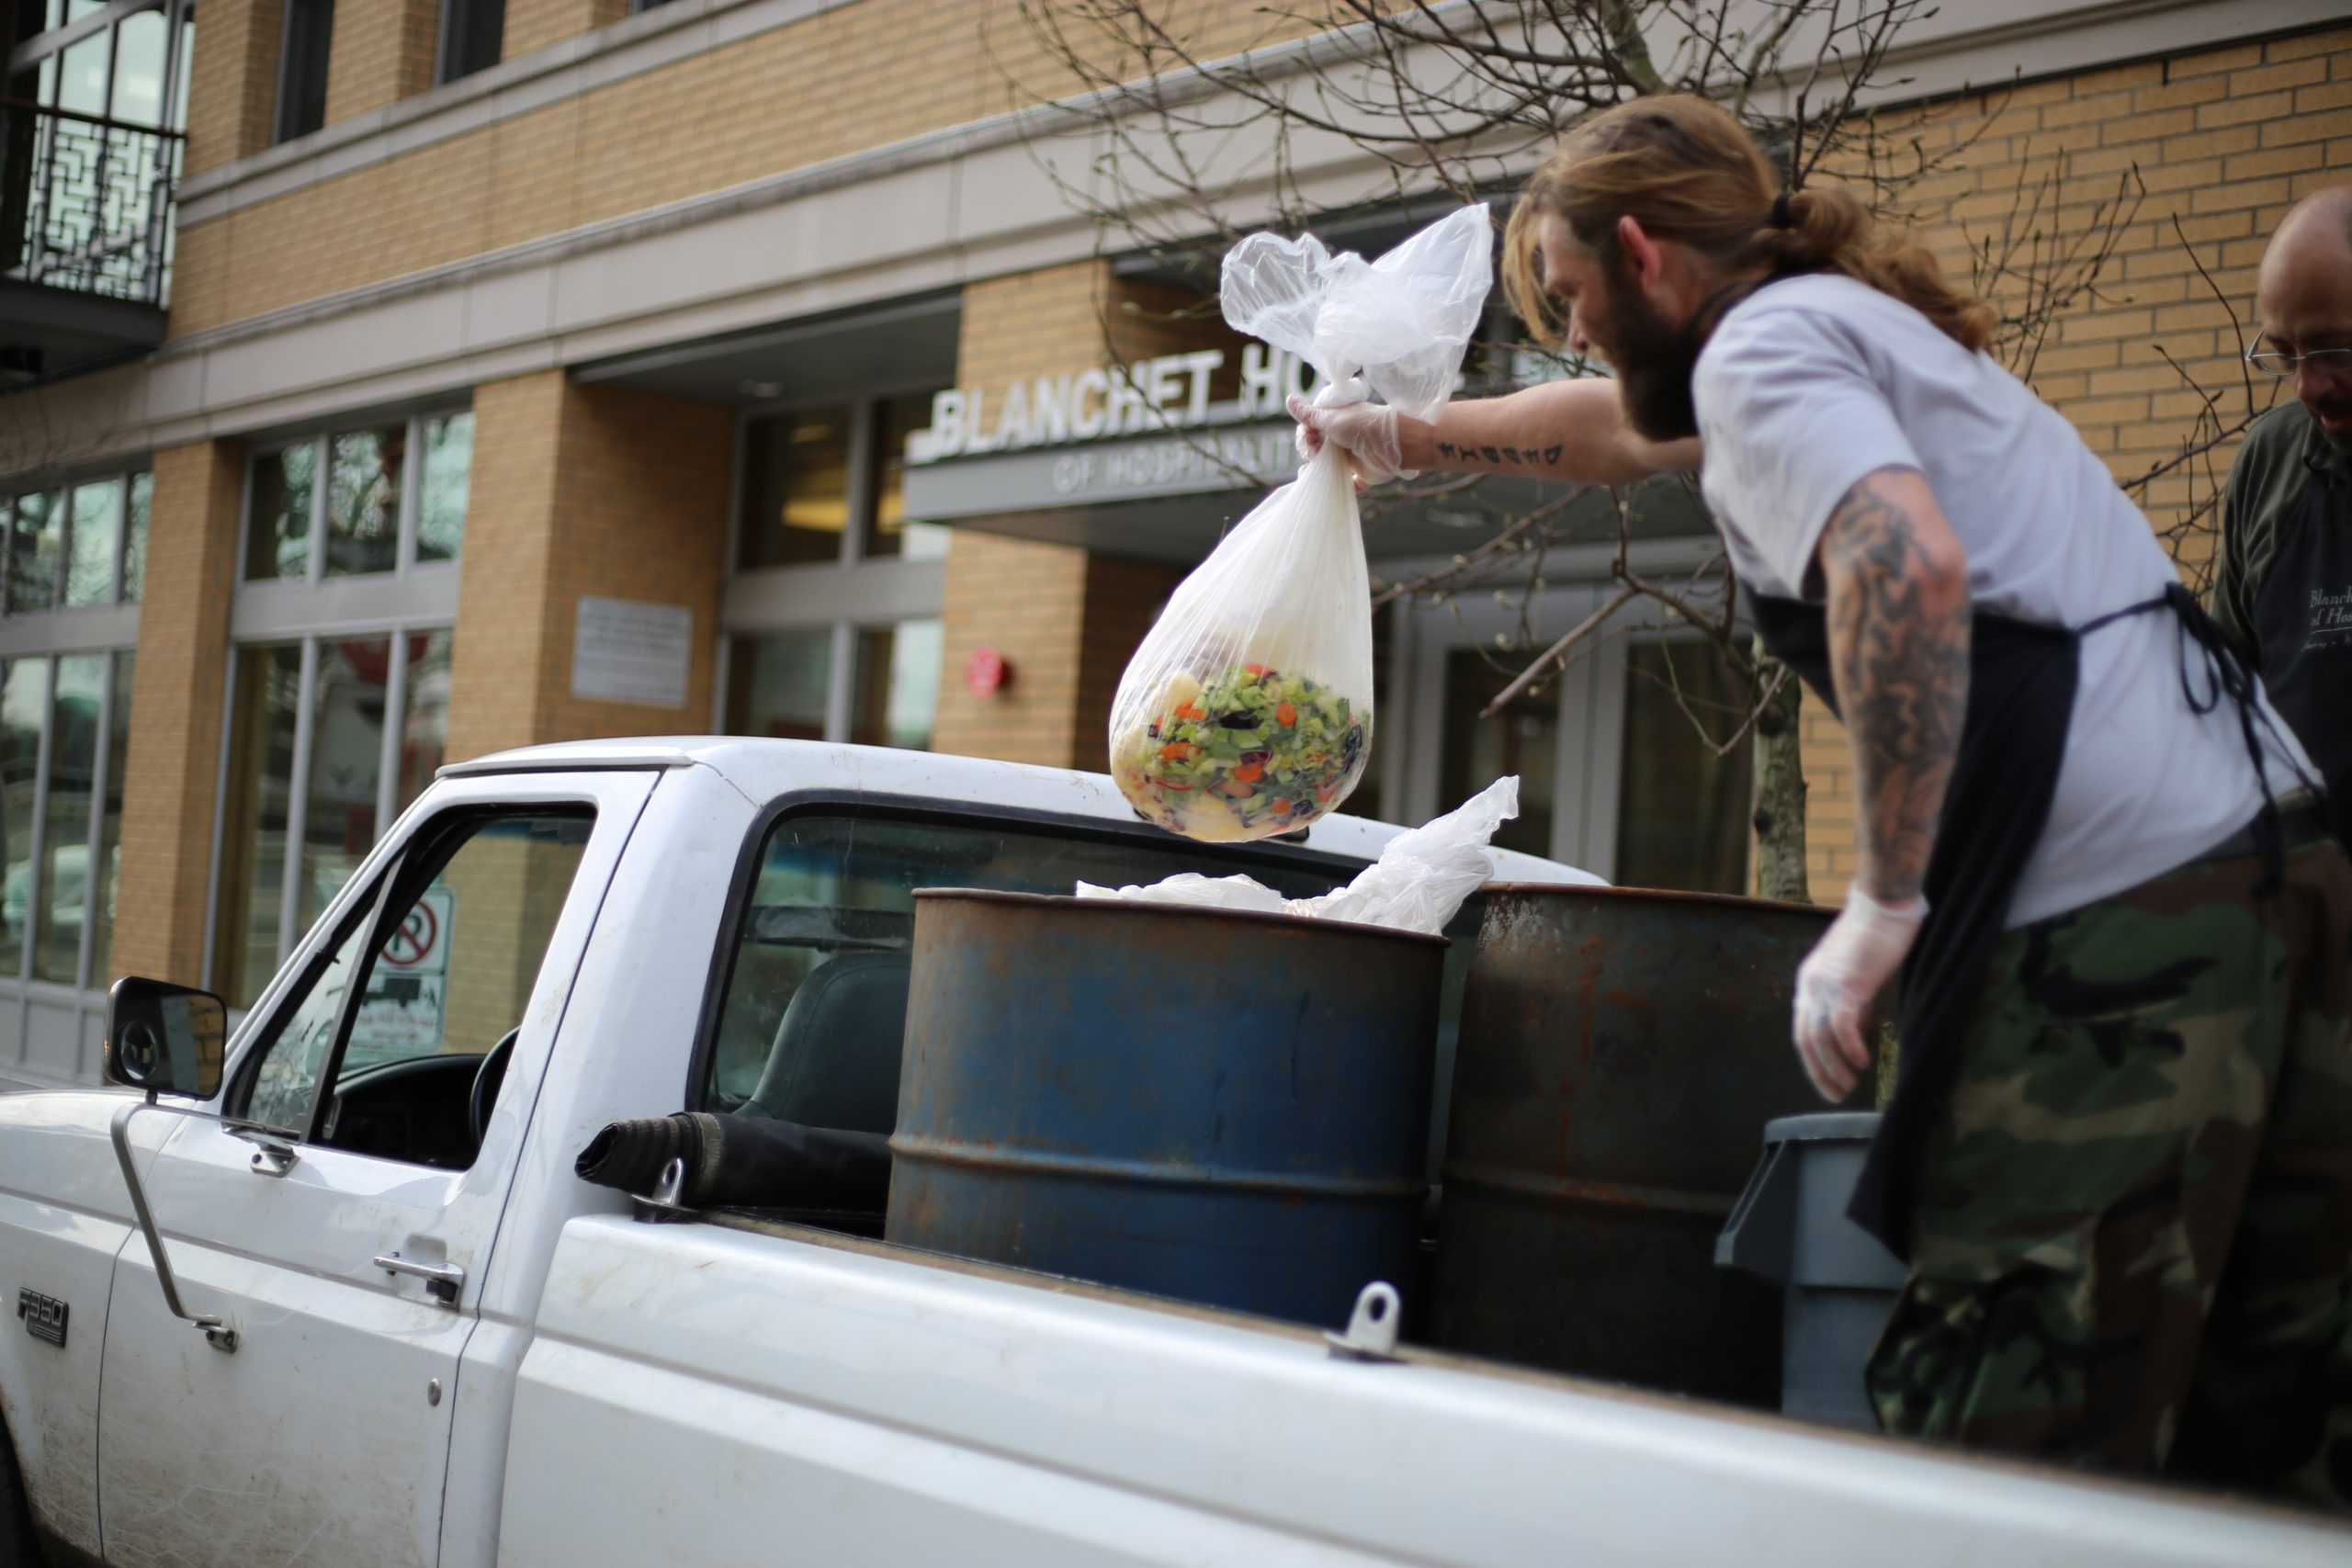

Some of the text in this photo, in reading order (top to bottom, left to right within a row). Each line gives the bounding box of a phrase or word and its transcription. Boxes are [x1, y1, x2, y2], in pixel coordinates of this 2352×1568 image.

[931, 348, 1225, 457] BLANCHET
[1052, 432, 1293, 494] OF HOSPITALIT
